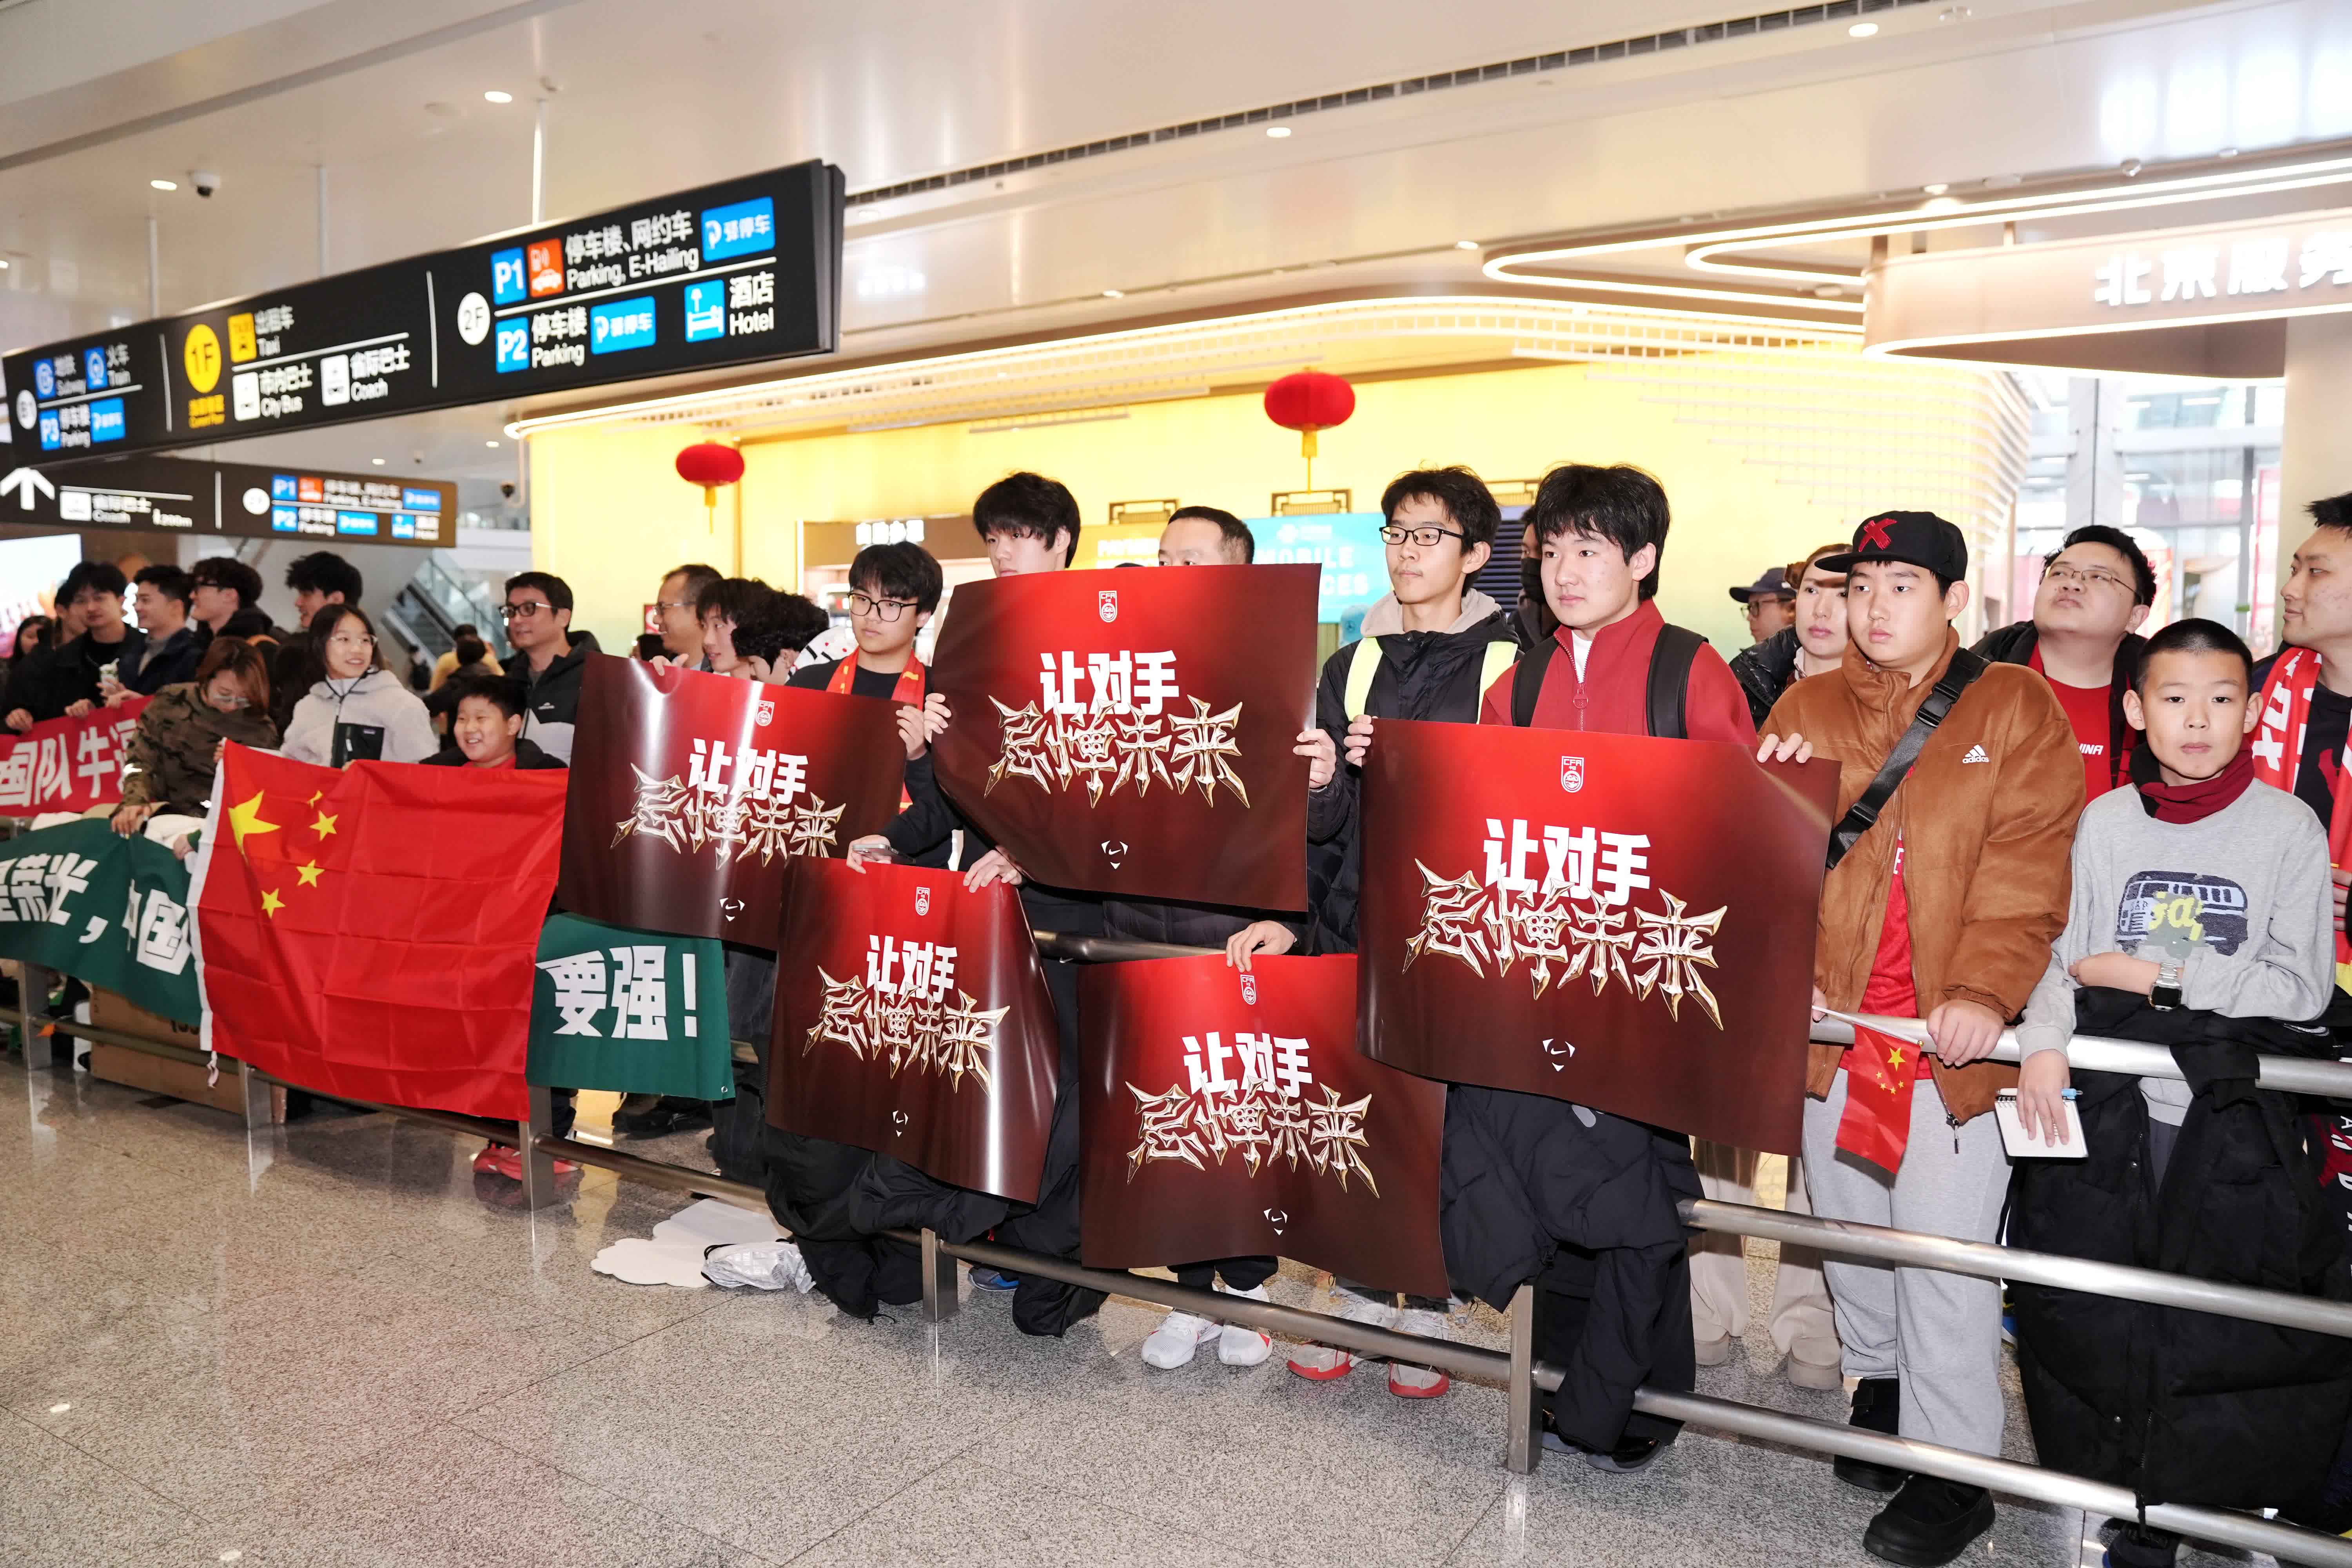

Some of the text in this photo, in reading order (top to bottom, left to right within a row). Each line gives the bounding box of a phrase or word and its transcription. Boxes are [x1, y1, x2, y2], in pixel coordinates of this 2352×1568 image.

[494, 258, 523, 294] P1
[629, 247, 699, 278] E-Hailing
[730, 271, 774, 309] 酒店
[532, 306, 587, 344] 停车楼
[730, 307, 774, 336] Hotel
[192, 343, 212, 375] 1F
[497, 329, 527, 363] P2
[532, 343, 584, 368] Parking
[351, 378, 388, 401] Coach
[275, 479, 297, 496] P1
[275, 509, 297, 527] P2
[1040, 650, 1179, 715] 让对手
[0, 718, 136, 807] 国队牛
[984, 694, 1250, 809] 忌惮未来
[1564, 759, 1582, 767] CFA
[1962, 755, 1989, 764] adidas
[2079, 743, 2104, 755] INA
[688, 738, 808, 804] 让对手
[1483, 818, 1651, 906] 让对手
[1402, 858, 1727, 1031] 忌惮未来
[866, 935, 958, 1004] 让对手
[535, 946, 697, 1041] 要强！
[802, 965, 1011, 1098] 忌惮未来
[1182, 1031, 1312, 1097] 让对手
[1125, 1075, 1379, 1198] 忌惮未来
